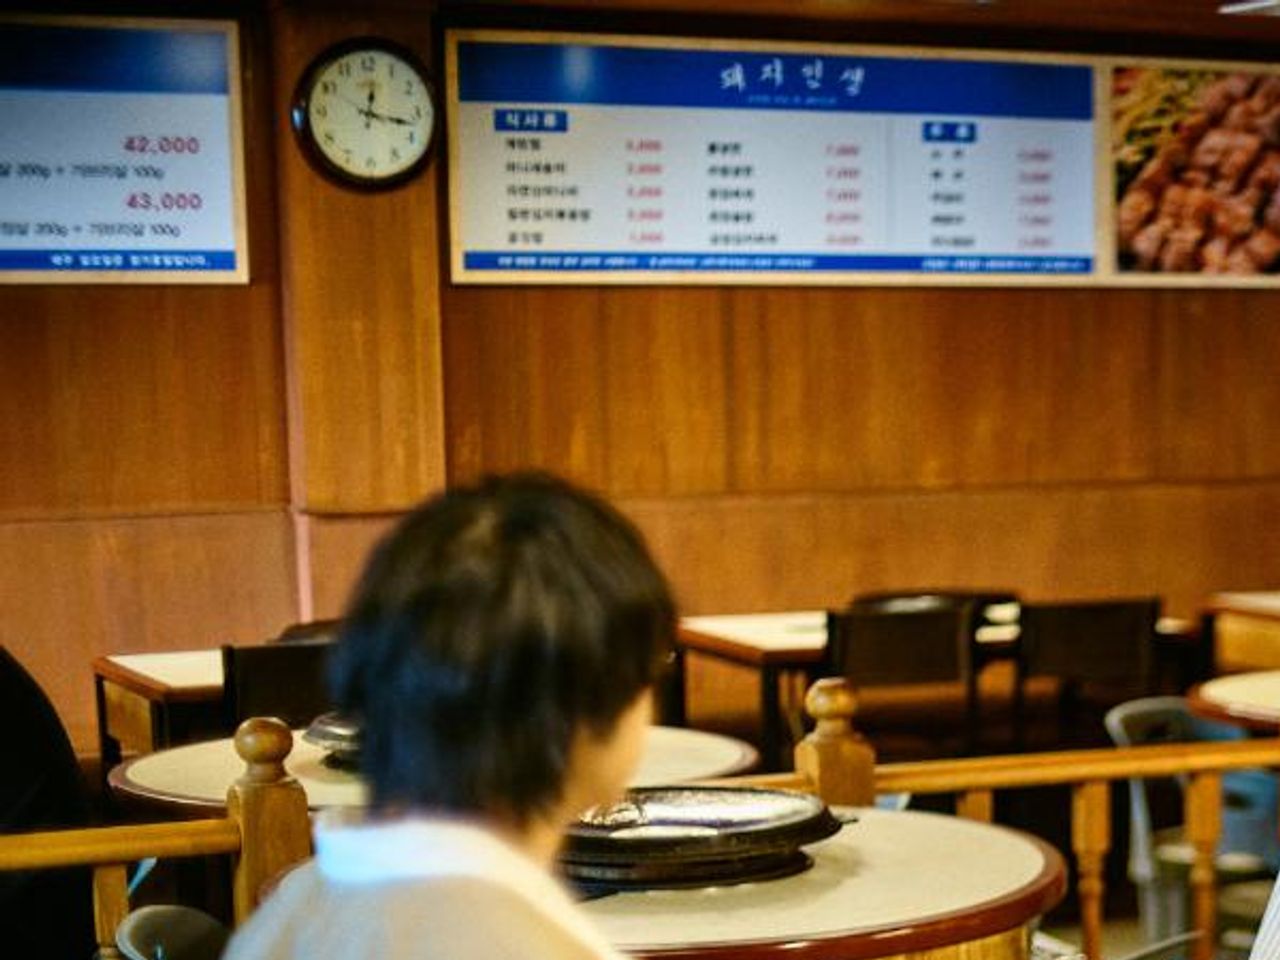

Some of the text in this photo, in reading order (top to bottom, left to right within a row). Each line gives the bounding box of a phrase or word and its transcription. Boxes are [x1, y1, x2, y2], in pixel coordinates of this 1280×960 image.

[720, 57, 865, 97] 돼지인생
[123, 135, 201, 154] 42,000
[126, 192, 203, 212] 43,000
